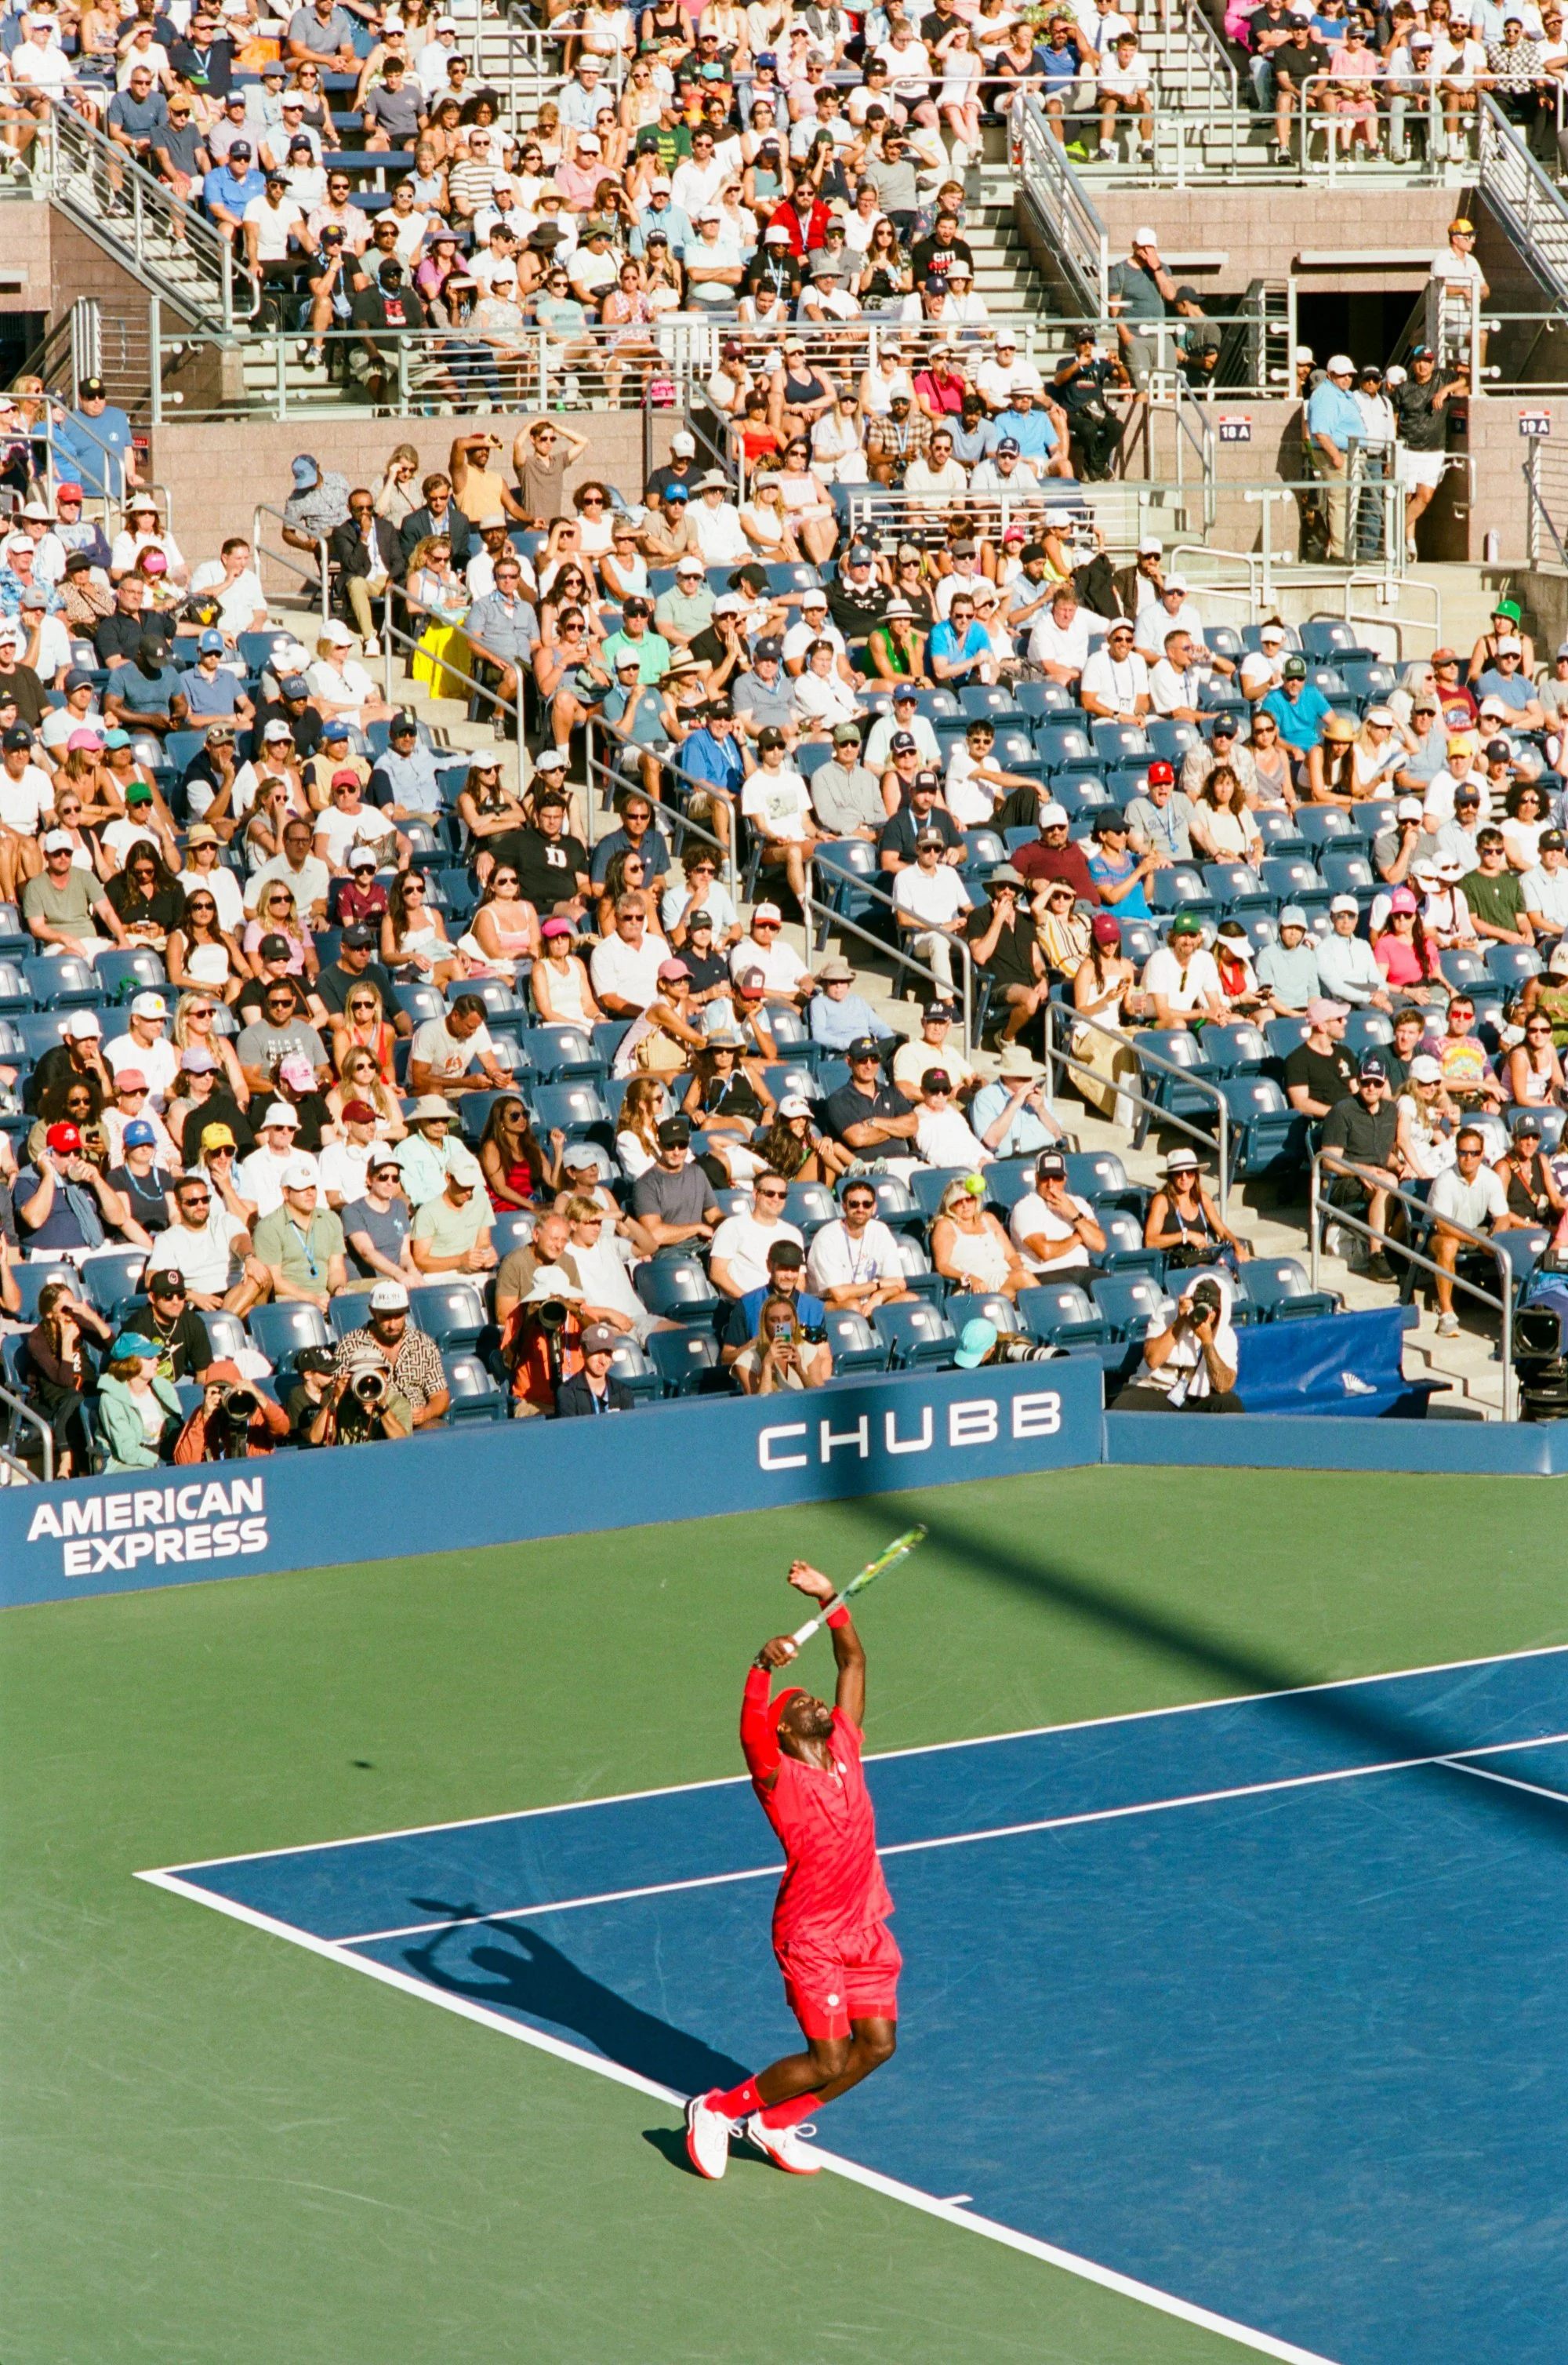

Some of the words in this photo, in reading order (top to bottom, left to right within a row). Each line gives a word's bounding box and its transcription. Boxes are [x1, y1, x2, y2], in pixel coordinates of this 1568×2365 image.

[933, 250, 956, 263] CITI
[1221, 426, 1236, 439] 18
[1239, 426, 1250, 439] A
[1521, 420, 1536, 433] 19
[1538, 420, 1549, 433] A
[545, 846, 568, 868] D
[758, 1391, 1061, 1471] CHUBB
[27, 1477, 263, 1542] AMERICAN
[64, 1517, 270, 1577] EXPRESS
